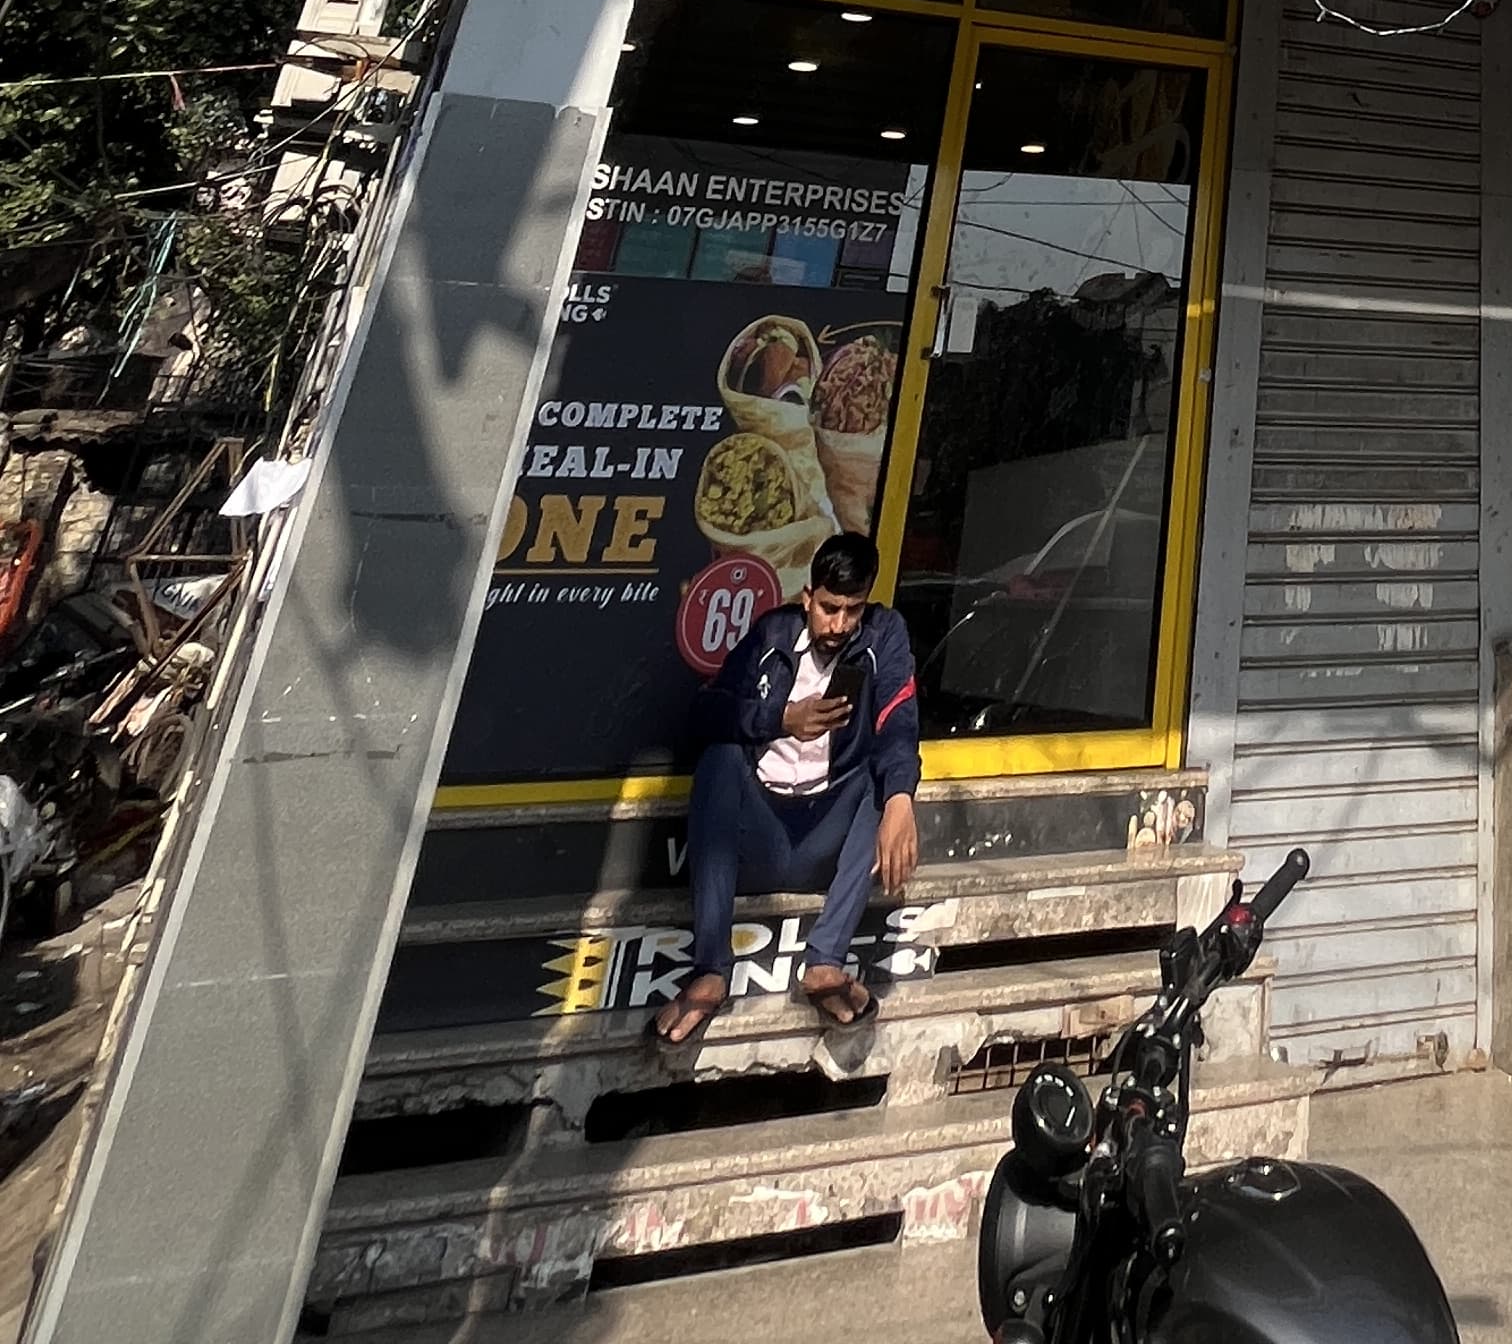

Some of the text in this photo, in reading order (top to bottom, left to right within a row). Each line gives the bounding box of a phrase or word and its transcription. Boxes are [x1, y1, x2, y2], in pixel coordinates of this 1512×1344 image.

[590, 164, 905, 215] SHAAN ENTERPRISES
[586, 198, 645, 223] STIN
[567, 283, 611, 303] LLS
[538, 400, 723, 431] COMPLETE
[518, 445, 683, 479] EAL-IN
[527, 584, 549, 602] in
[557, 585, 615, 610] every
